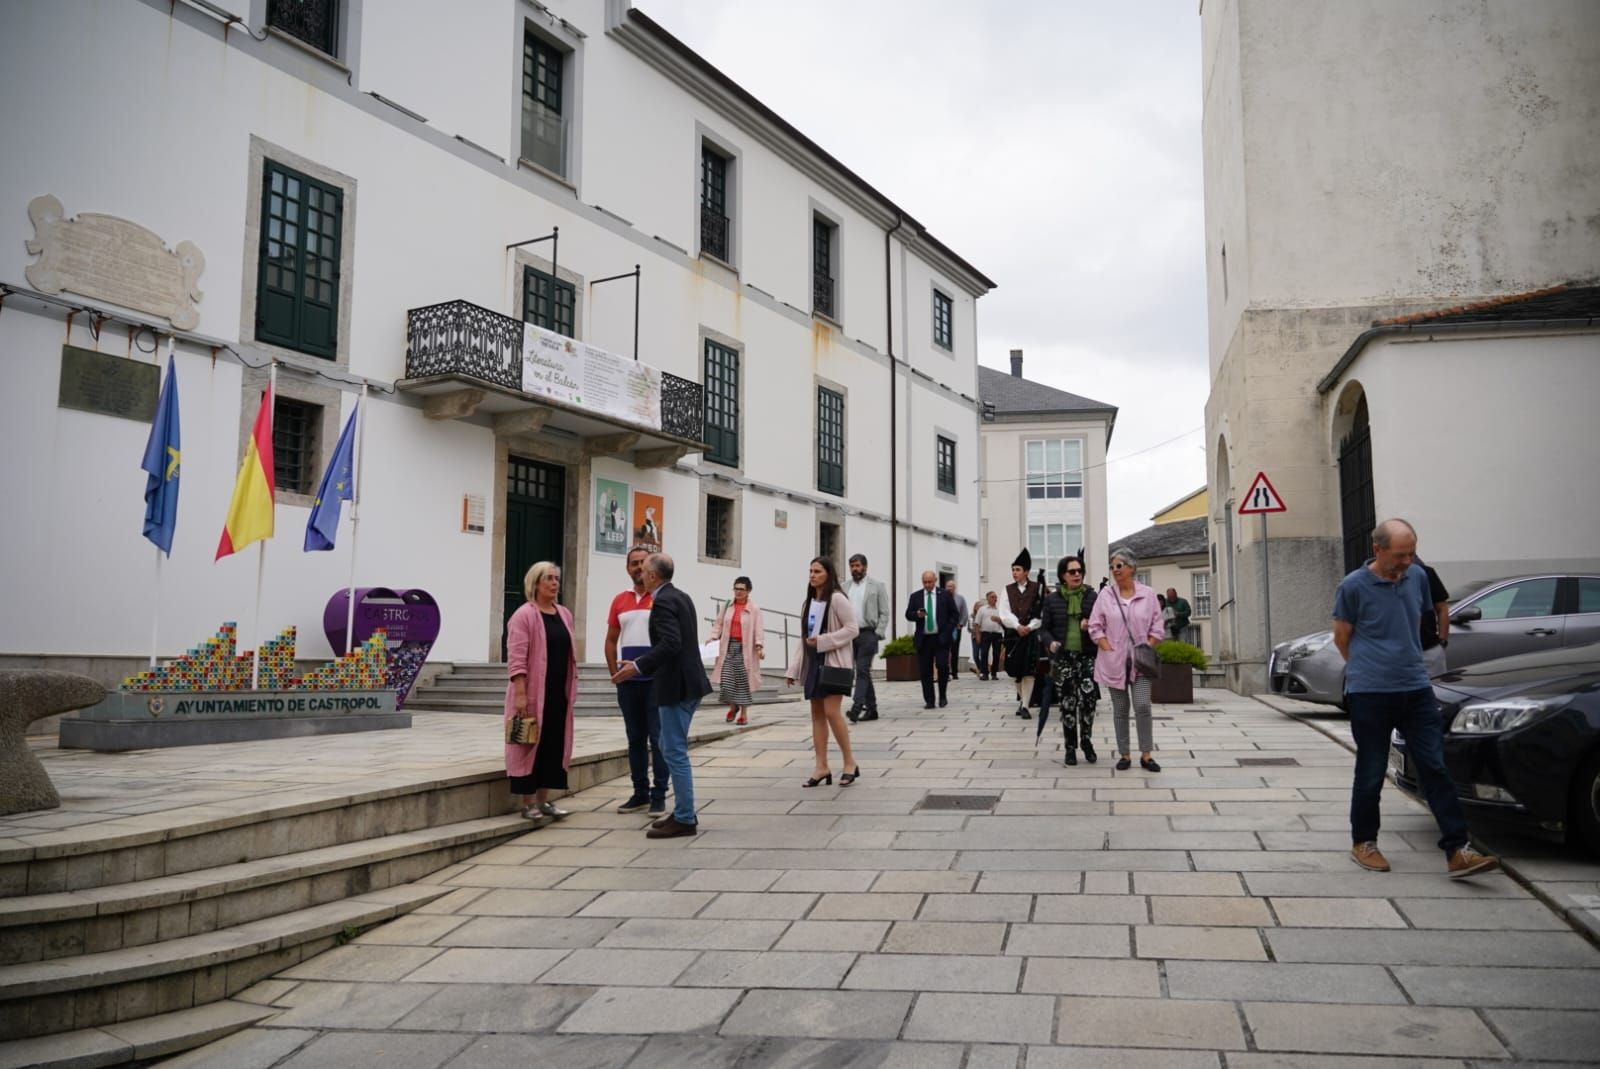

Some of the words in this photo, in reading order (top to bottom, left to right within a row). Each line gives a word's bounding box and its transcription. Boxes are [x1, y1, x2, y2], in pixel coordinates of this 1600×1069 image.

[175, 698, 285, 714] AYUNTAMIENTO
[287, 698, 305, 711] DE
[308, 697, 382, 710] CASTROPOL
